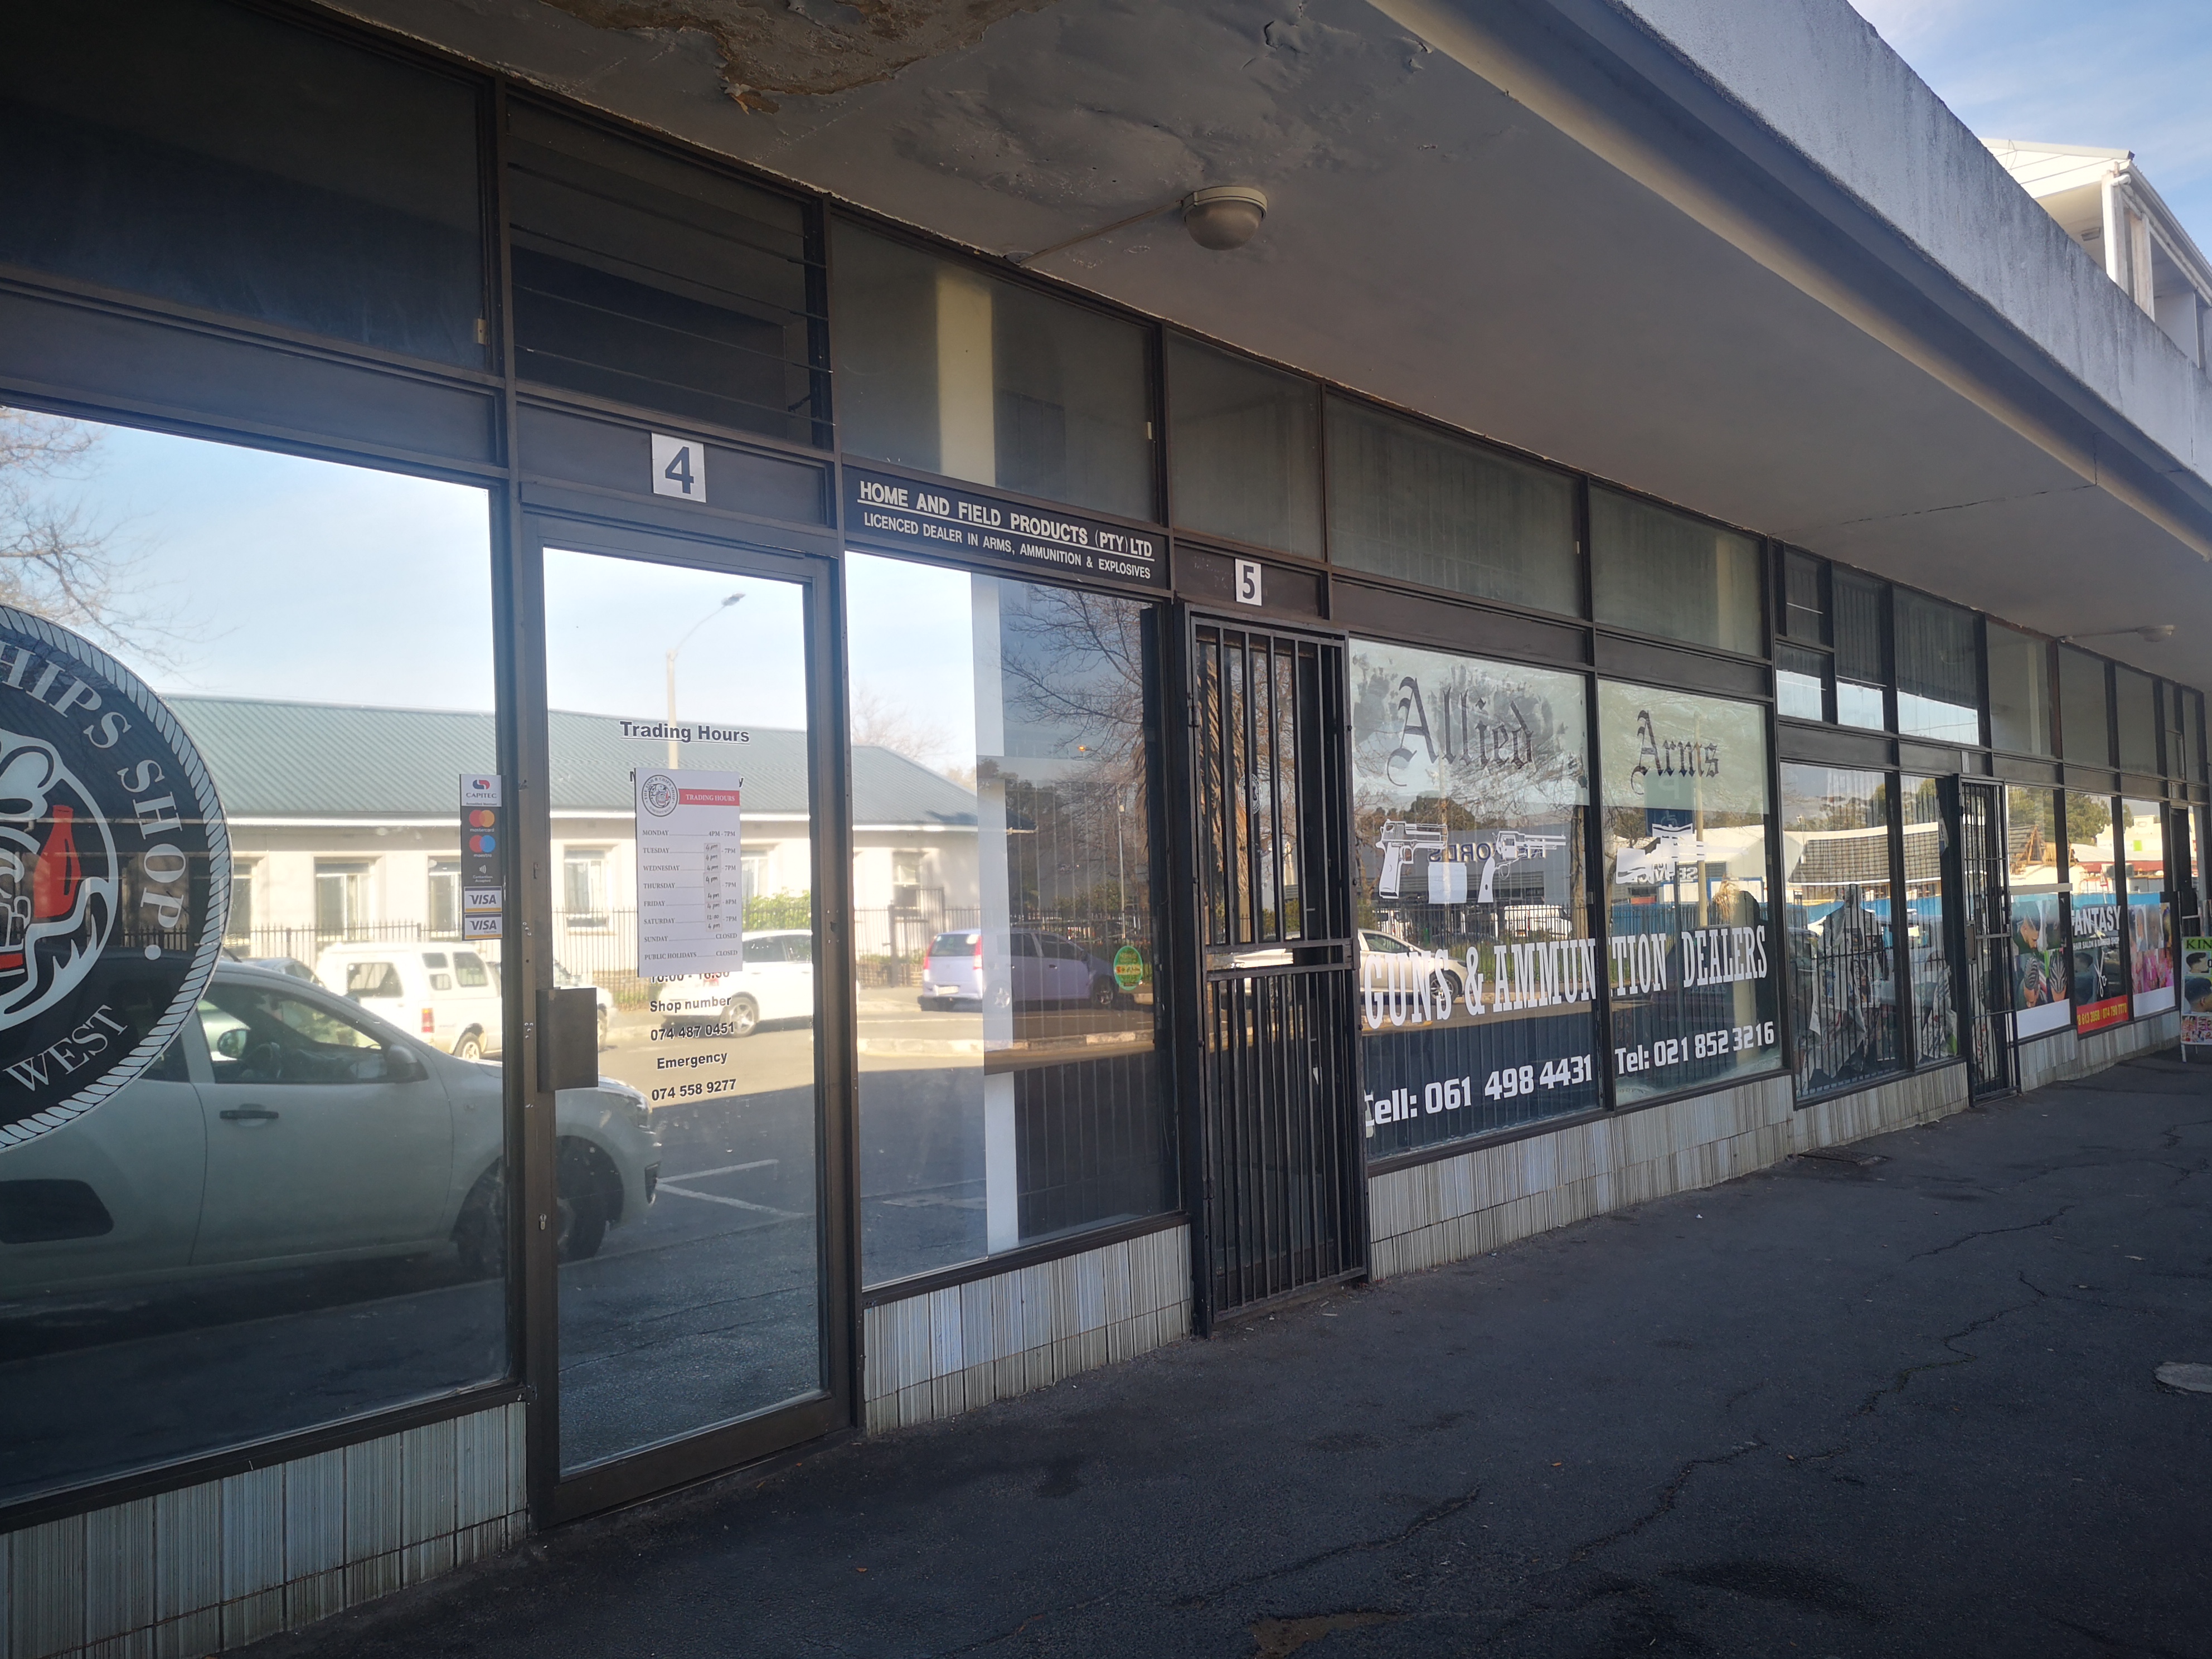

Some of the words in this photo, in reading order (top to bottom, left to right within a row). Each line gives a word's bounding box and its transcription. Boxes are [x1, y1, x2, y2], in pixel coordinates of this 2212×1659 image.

[665, 447, 694, 494] 4
[860, 481, 909, 507] HOME
[916, 493, 950, 516] AND
[958, 502, 1001, 526] FIELD
[1010, 513, 1088, 545] PRODUCTS
[864, 512, 919, 535] LICENCED
[923, 523, 962, 543] DEALER
[968, 532, 978, 547] IN
[983, 536, 1015, 555] ARMS,
[1020, 544, 1081, 566] AMMUNITION
[1086, 556, 1093, 568] &
[1099, 559, 1151, 579] EXPLOSIVES
[1243, 565, 1255, 599] 5
[620, 721, 691, 743] Trading
[698, 725, 749, 742] Hours
[1386, 676, 1534, 787] Allied
[1631, 710, 1719, 795] Arms
[117, 759, 187, 929] SHOP
[469, 895, 496, 904] VISA
[469, 920, 497, 930] VISA
[2082, 940, 2094, 949] SALON
[1365, 949, 1451, 1029] GUNS
[1464, 947, 1485, 1016] &
[1493, 933, 1666, 1012] AMMUNTION
[1681, 925, 1767, 988] DEALERS
[650, 1001, 681, 1013] Shop
[685, 997, 731, 1010] number
[3, 1005, 128, 1091] WEST
[651, 1029, 674, 1041] 074
[678, 1026, 701, 1038] 487
[706, 1022, 734, 1036] 0451
[1614, 1045, 1650, 1074] Tel:
[1653, 1037, 1689, 1067] 021
[1695, 1030, 1728, 1059] 852
[1733, 1021, 1774, 1051] 3216
[657, 1052, 727, 1069] Emergency
[1425, 1076, 1471, 1114] 061
[1485, 1065, 1534, 1101] 498
[1540, 1054, 1592, 1089] 4431
[652, 1087, 676, 1100] 074
[680, 1084, 702, 1097] 558
[706, 1079, 736, 1093] 9277
